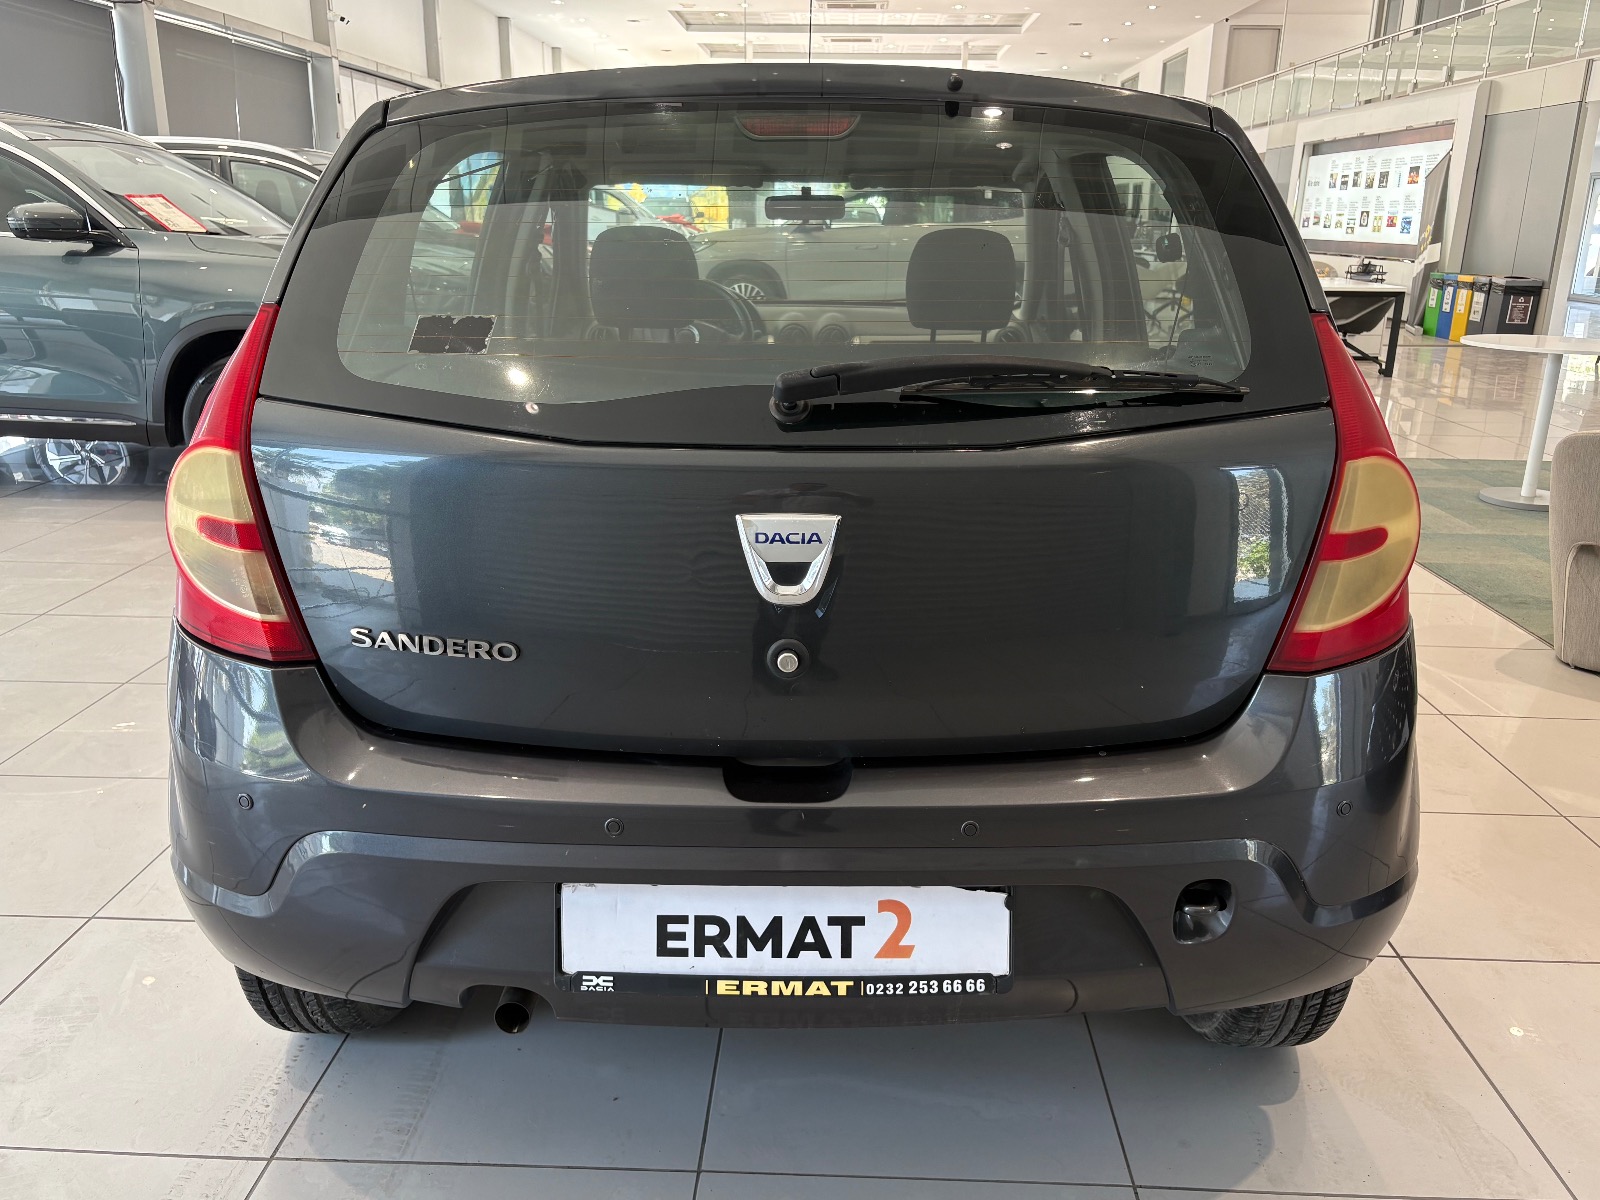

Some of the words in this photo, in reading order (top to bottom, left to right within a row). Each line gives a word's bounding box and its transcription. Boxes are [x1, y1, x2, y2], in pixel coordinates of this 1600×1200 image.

[754, 532, 823, 545] DACIA
[350, 626, 521, 662] SANDERO
[656, 914, 866, 959] ERMAT
[874, 899, 916, 959] 2
[716, 979, 854, 996] ERMAT
[866, 983, 904, 996] 0232
[908, 980, 940, 995] 253
